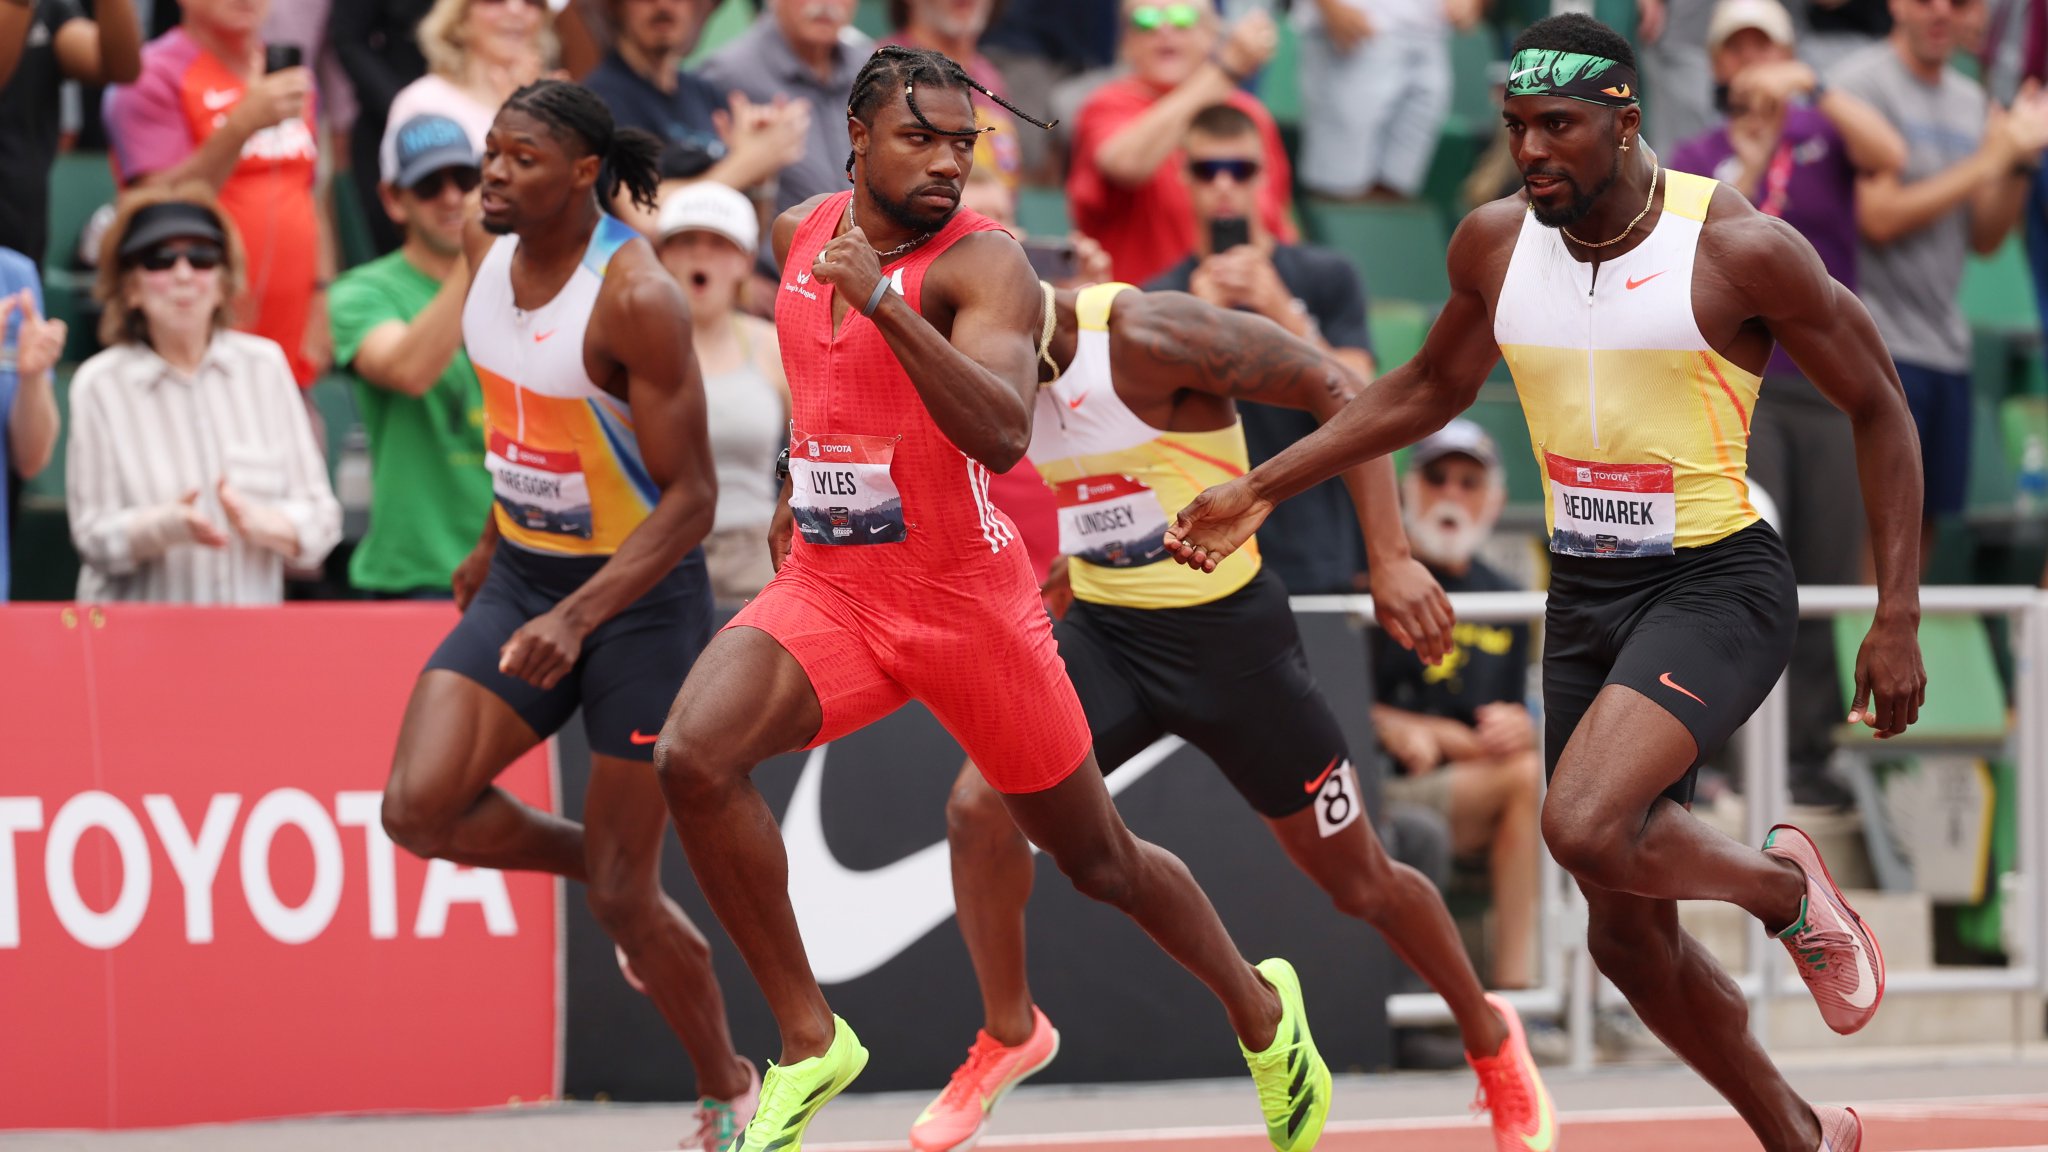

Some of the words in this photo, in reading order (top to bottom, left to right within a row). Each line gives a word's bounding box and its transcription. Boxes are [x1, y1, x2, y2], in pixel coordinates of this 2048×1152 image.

[821, 444, 852, 454] TOYOTA
[811, 470, 857, 496] LYLES
[1593, 471, 1629, 482] TOYOTA
[1074, 503, 1135, 535] LINDSEY
[1563, 492, 1654, 525] BEDNAREK
[1323, 774, 1350, 824] 8
